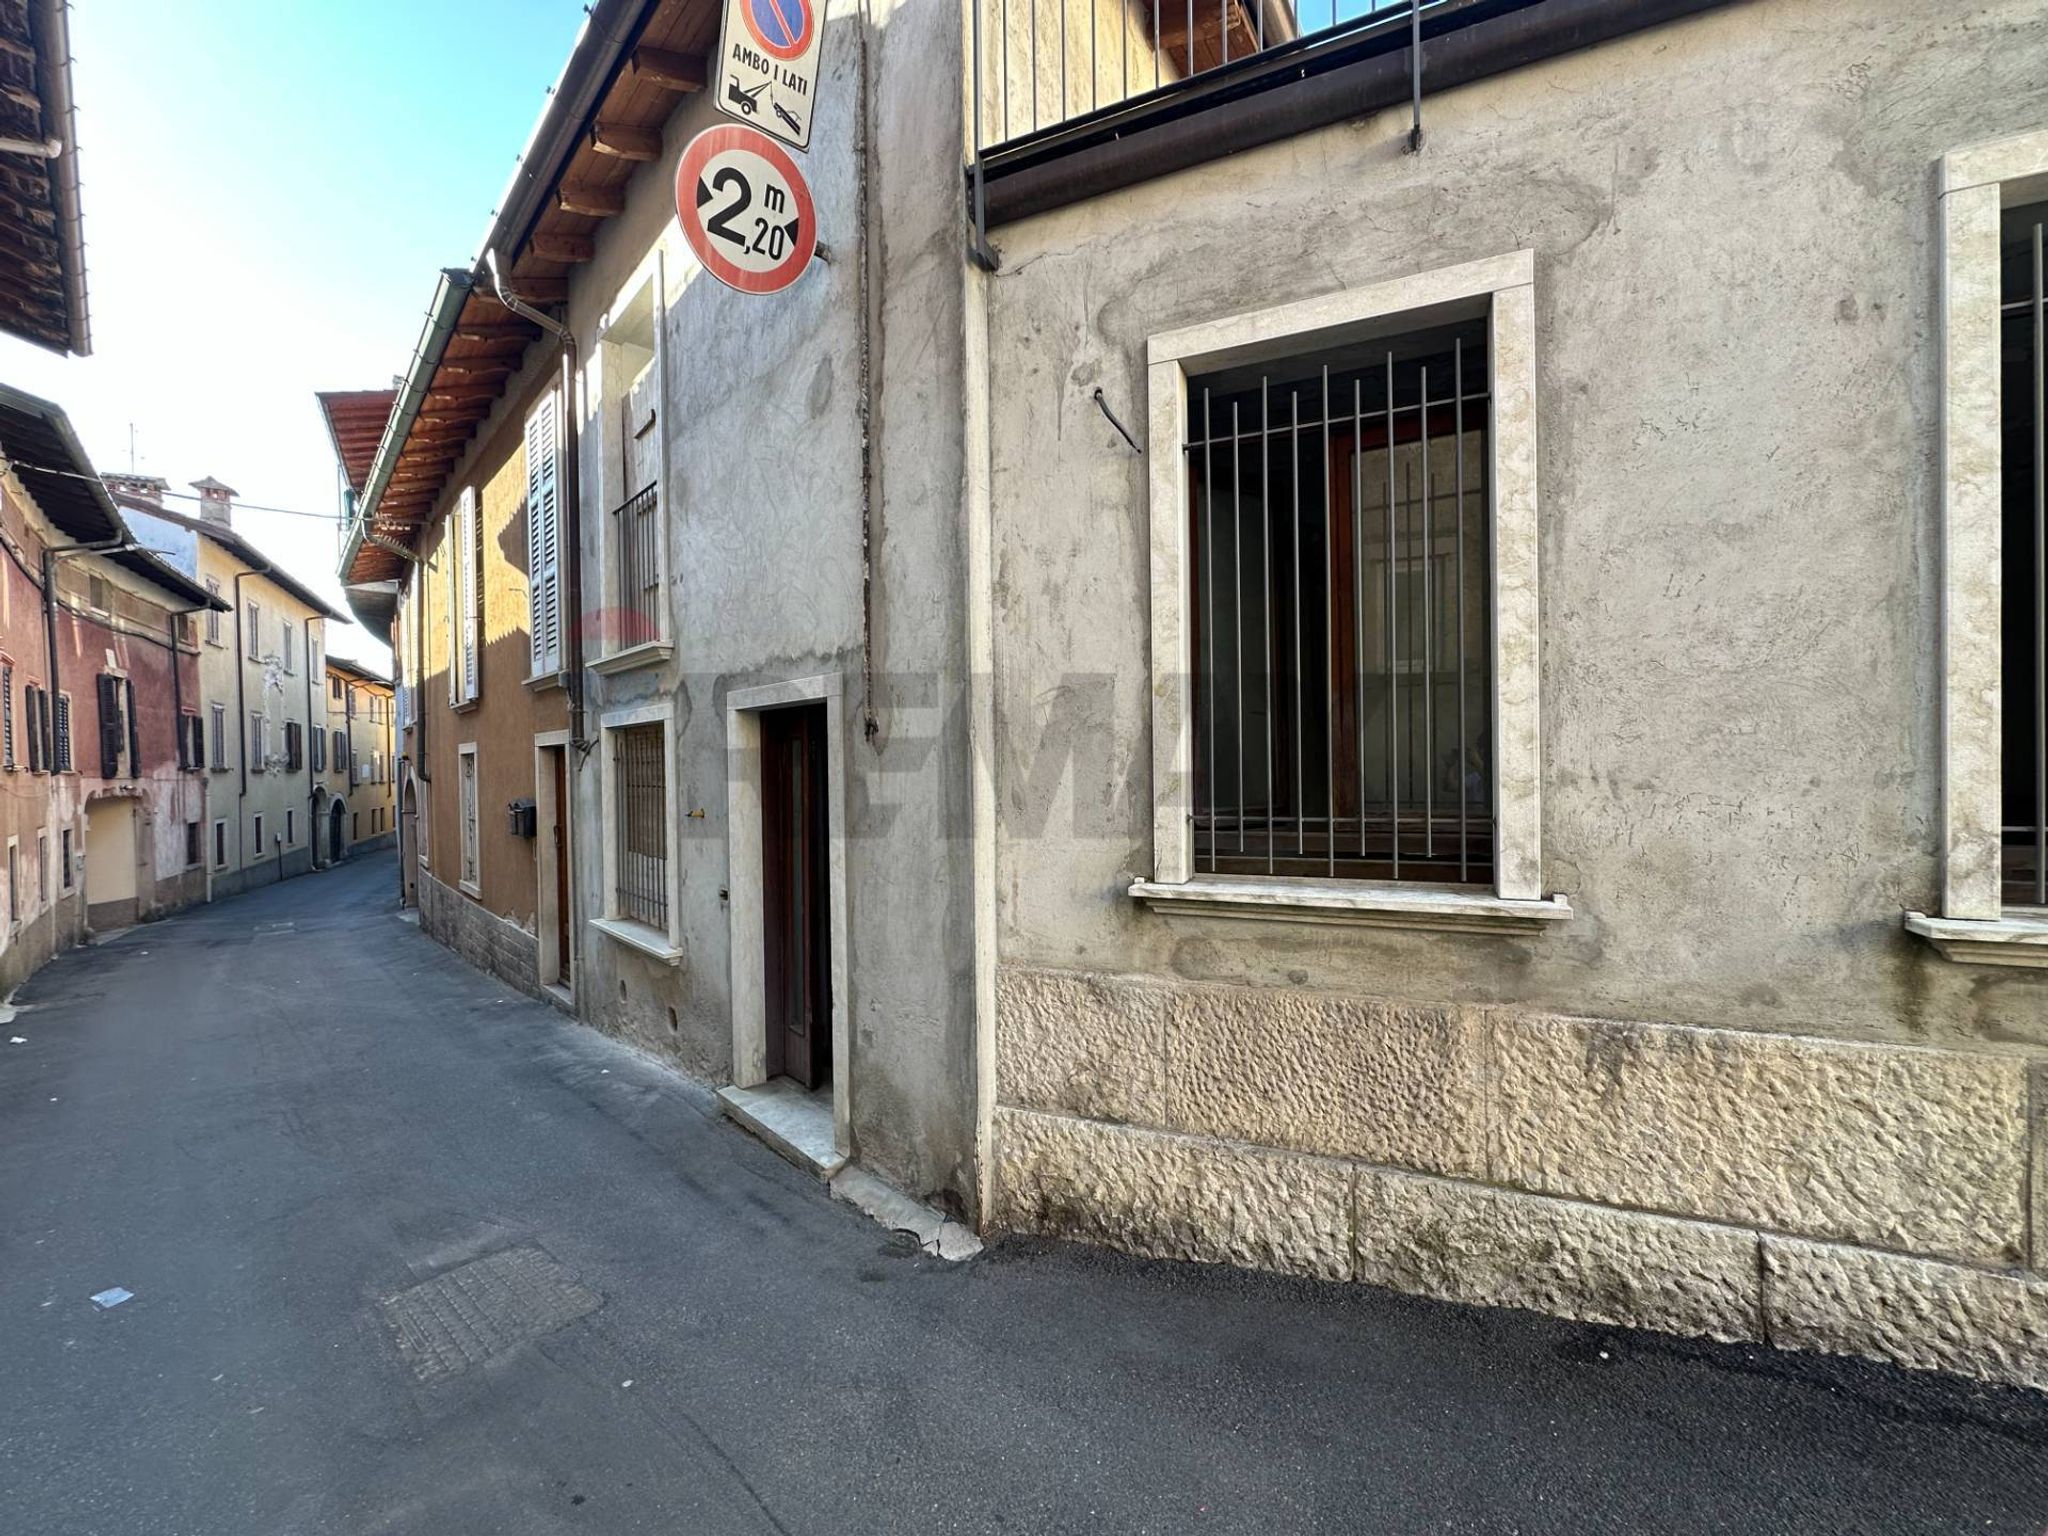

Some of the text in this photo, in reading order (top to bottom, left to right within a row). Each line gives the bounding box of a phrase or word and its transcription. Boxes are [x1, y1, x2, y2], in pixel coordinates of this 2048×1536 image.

[732, 43, 808, 96] AMBO I LATI
[764, 183, 785, 214] m
